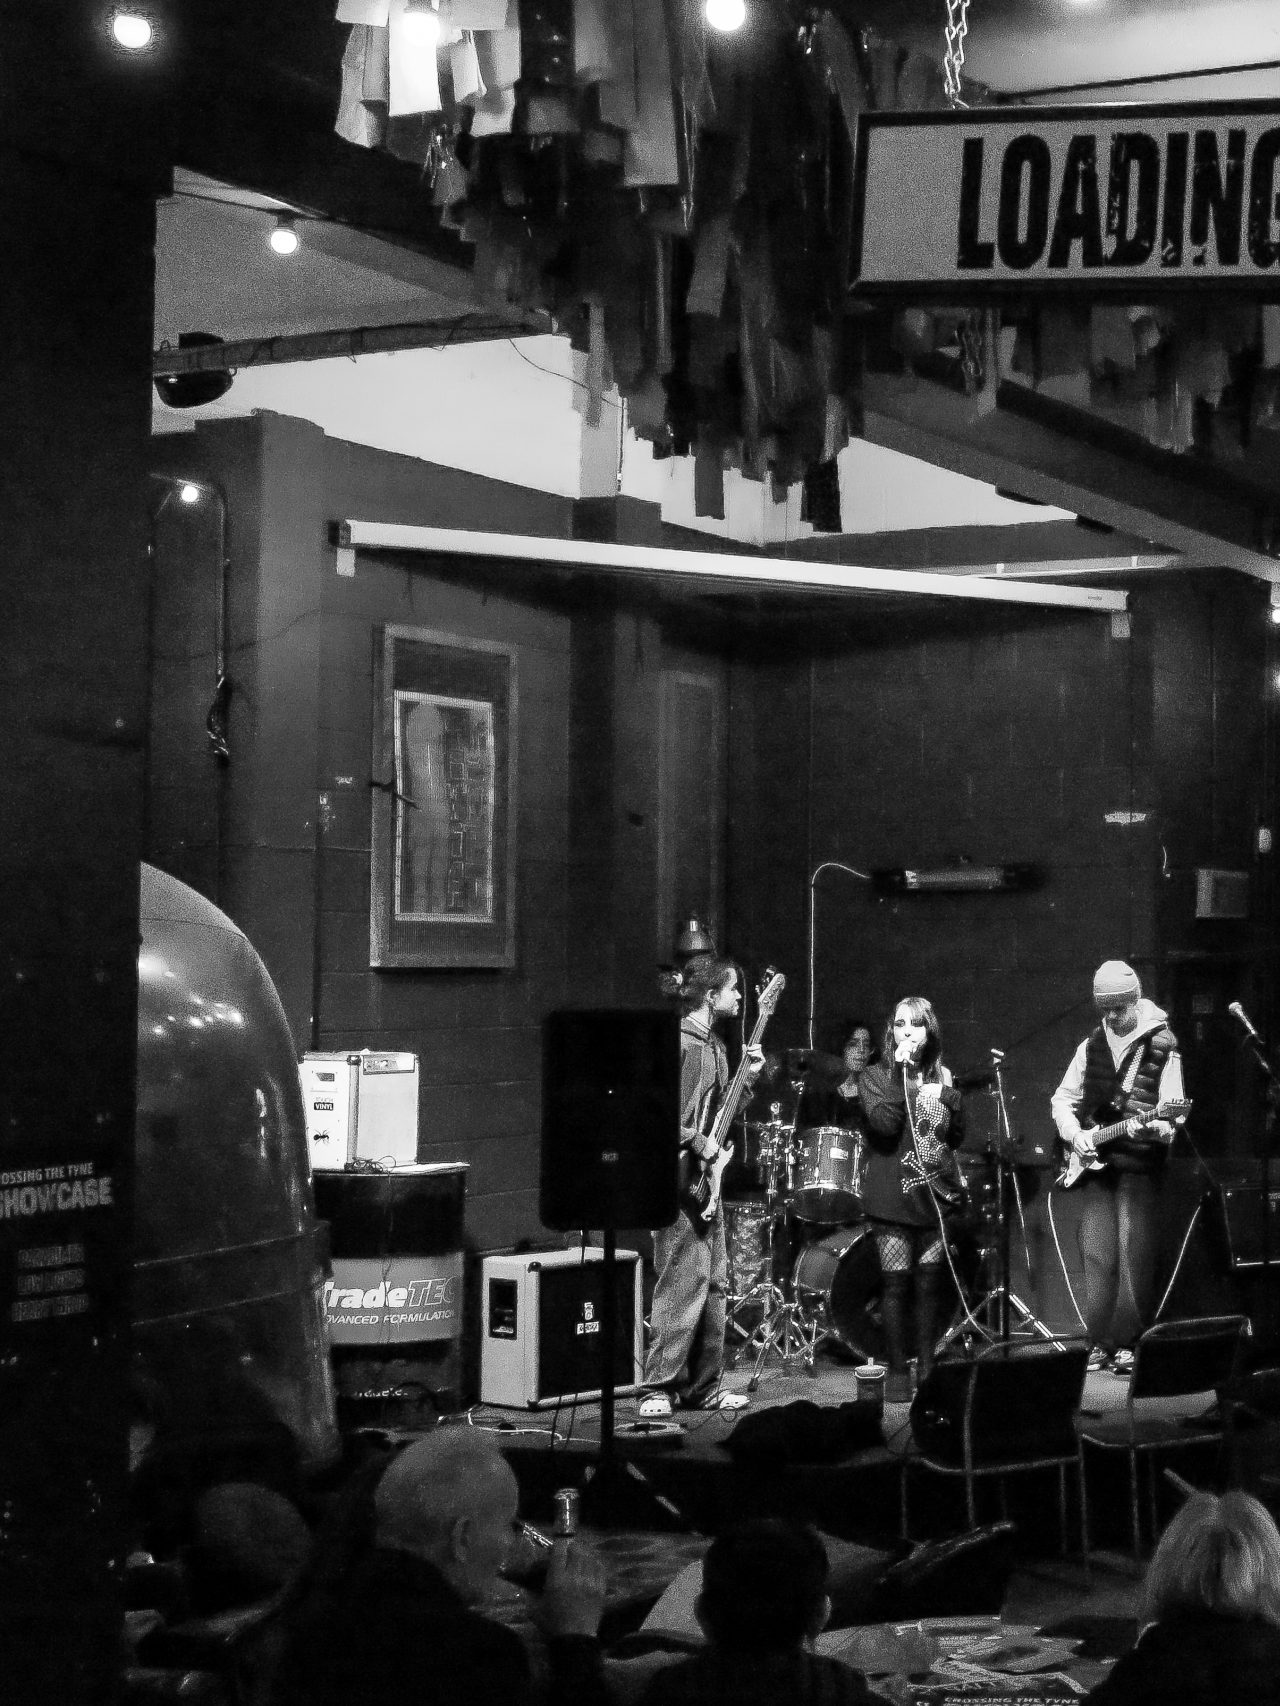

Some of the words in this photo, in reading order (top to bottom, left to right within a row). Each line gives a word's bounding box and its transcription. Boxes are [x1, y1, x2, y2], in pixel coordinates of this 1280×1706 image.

[0, 1169, 42, 1185] OSSING
[44, 1166, 65, 1180] THE
[67, 1162, 93, 1177] TYNE
[0, 1177, 112, 1218] HOWCASE
